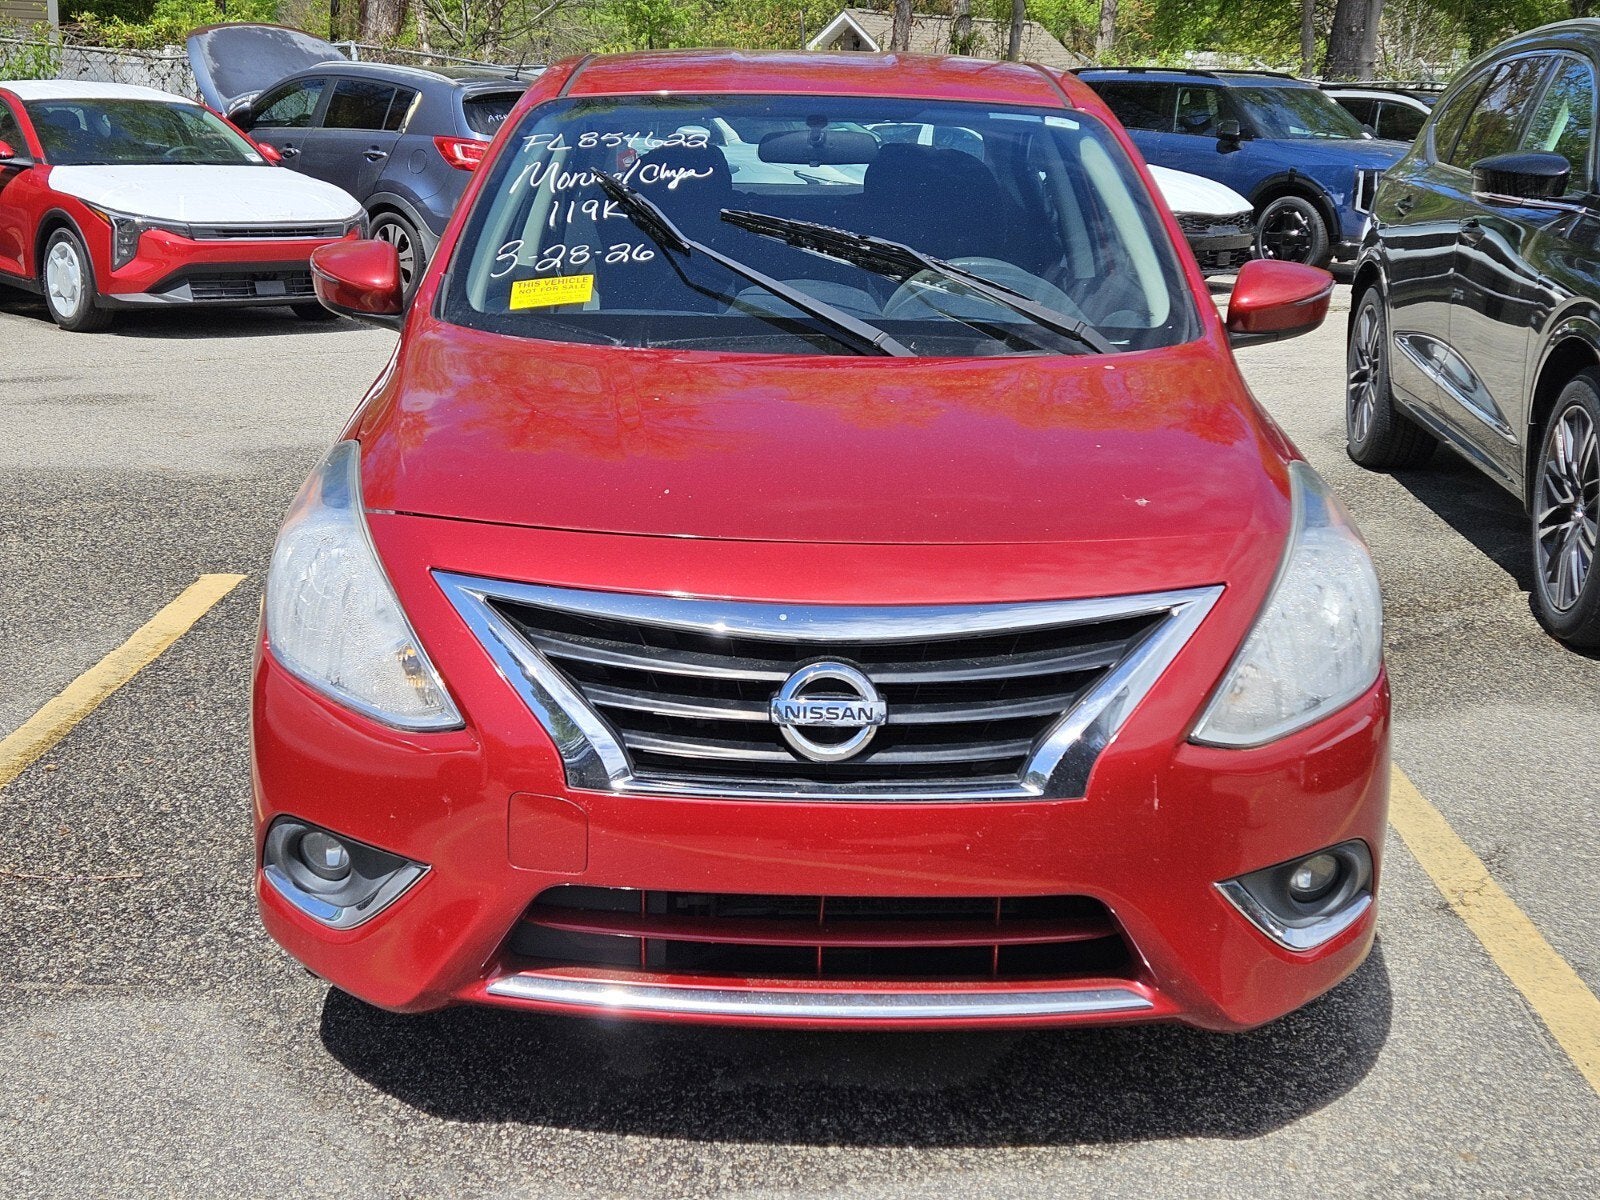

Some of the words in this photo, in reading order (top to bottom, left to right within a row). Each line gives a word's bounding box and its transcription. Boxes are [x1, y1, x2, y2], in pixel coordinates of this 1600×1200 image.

[549, 199, 629, 228] 119K
[490, 239, 655, 278] 3-28-26
[517, 280, 541, 289] THIS
[544, 276, 589, 286] VEHICLE
[784, 705, 874, 721] NISSAN
